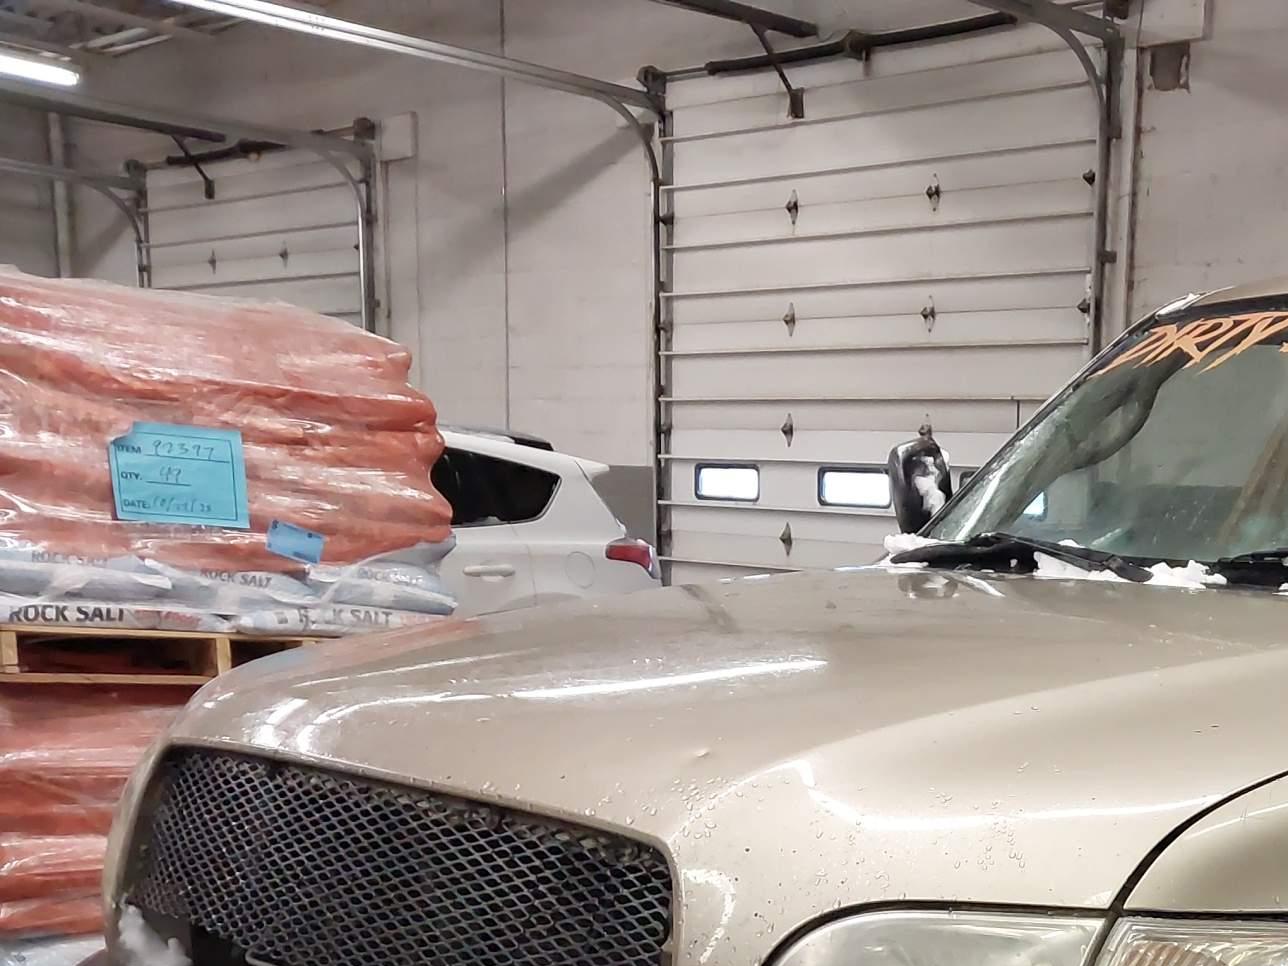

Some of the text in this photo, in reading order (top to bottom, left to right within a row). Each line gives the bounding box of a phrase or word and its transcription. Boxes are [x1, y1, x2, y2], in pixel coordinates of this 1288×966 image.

[239, 572, 272, 588] SALT
[9, 605, 69, 622] ROCK
[350, 609, 393, 626] SALT
